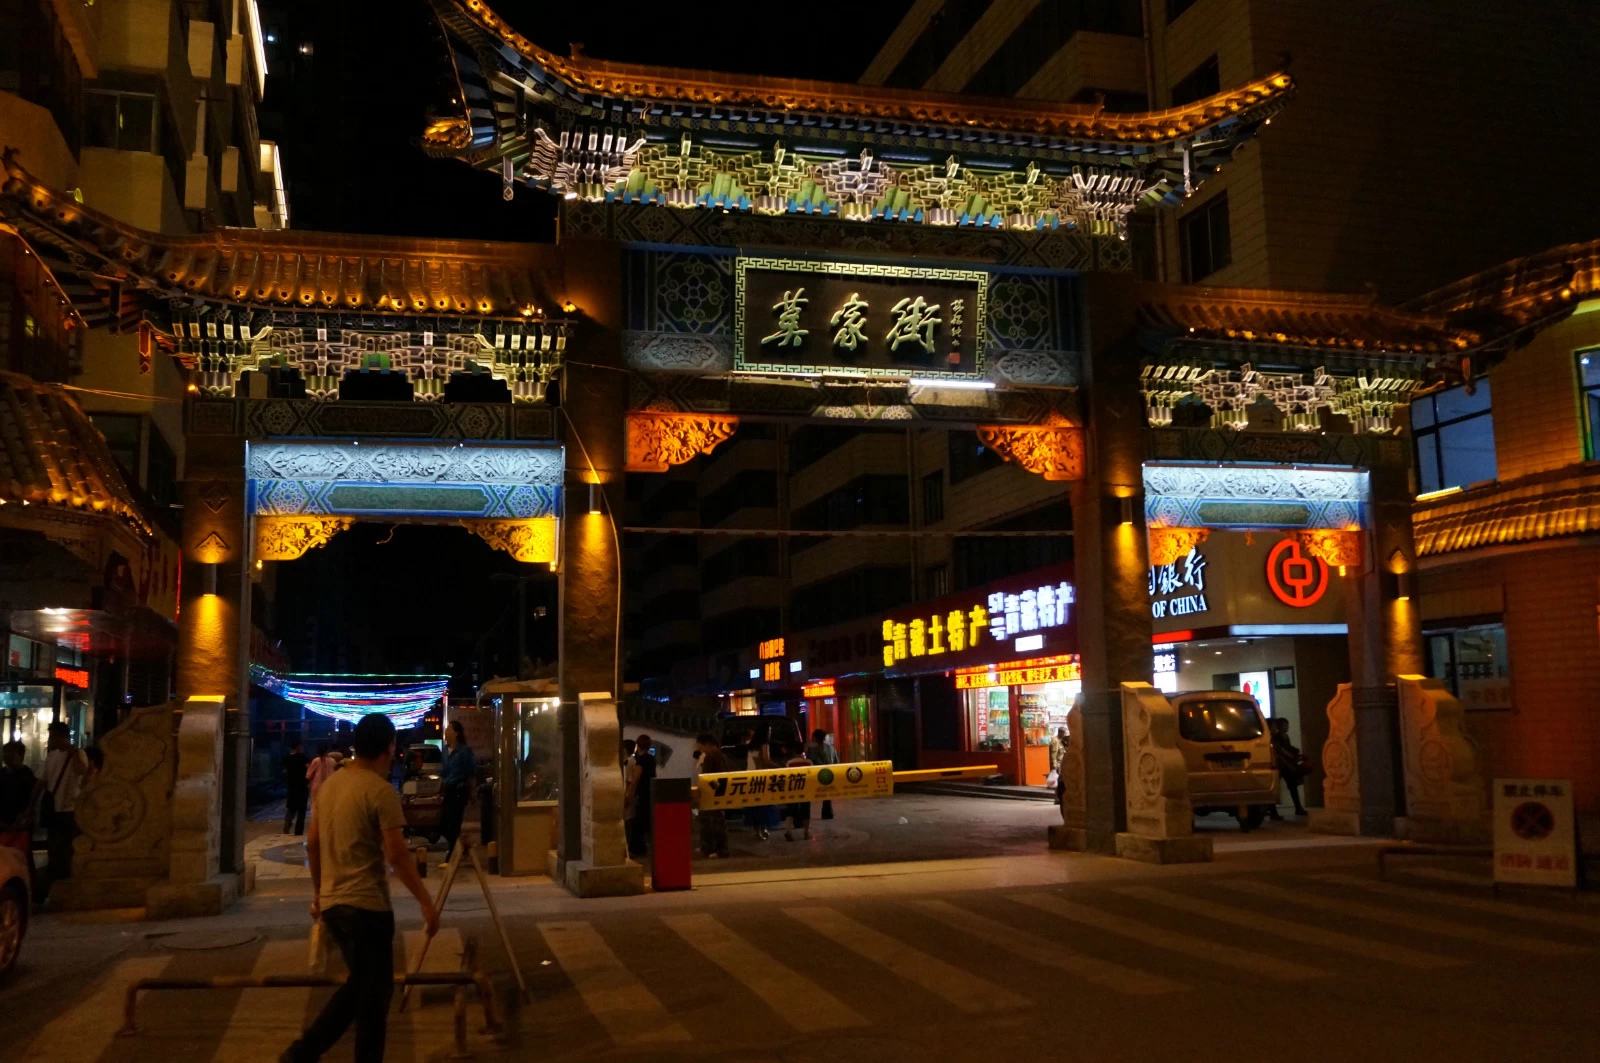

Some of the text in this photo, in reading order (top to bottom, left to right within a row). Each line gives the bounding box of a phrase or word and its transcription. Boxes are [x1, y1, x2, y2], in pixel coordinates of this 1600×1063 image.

[761, 287, 943, 354] 莫家街
[1152, 594, 1207, 618] OF CHINA
[729, 774, 807, 796] 元洲装饰
